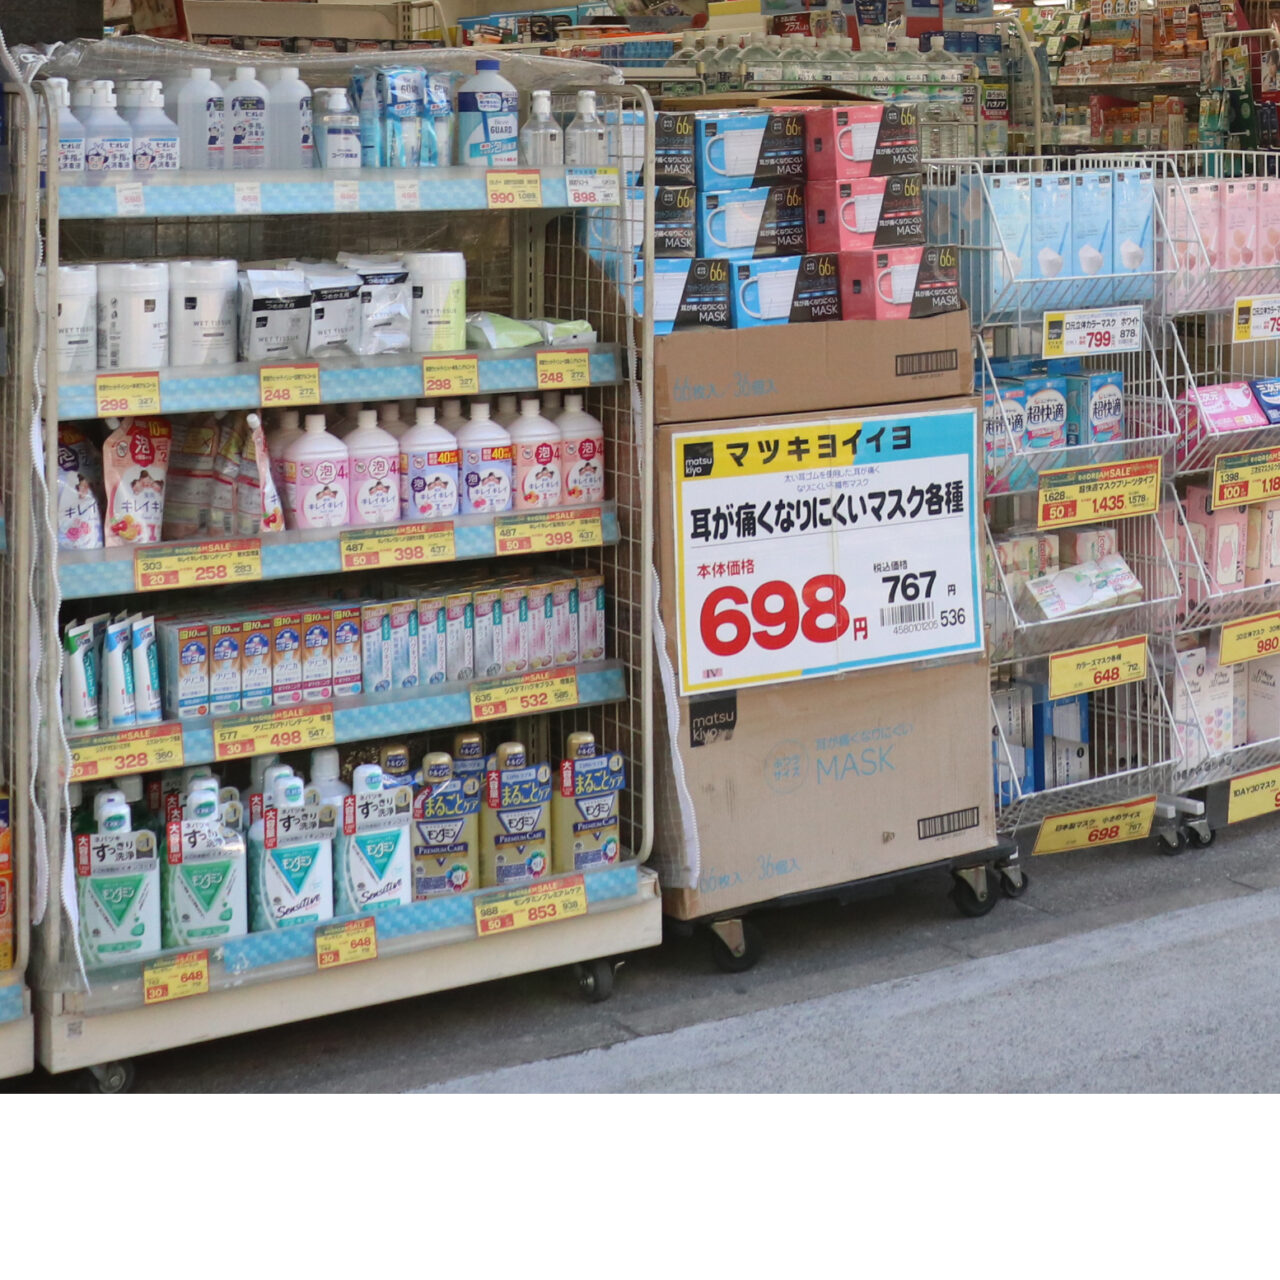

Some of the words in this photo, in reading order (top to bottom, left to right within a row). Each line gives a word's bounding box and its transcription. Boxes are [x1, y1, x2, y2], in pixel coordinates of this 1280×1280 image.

[489, 125, 513, 134] GUARD
[893, 153, 919, 165] MASK
[664, 163, 692, 175] MASK
[777, 164, 803, 175] MASK
[490, 192, 515, 204] 990
[573, 191, 596, 203] 898
[896, 224, 922, 236] MASK
[665, 237, 693, 248] MASK
[777, 234, 803, 247] MASK
[699, 310, 727, 322] MASK
[811, 304, 838, 316] MASK
[1086, 331, 1111, 348] 799
[1119, 329, 1136, 338] 878
[540, 372, 564, 384] 248
[426, 379, 451, 391] 298
[264, 388, 290, 401] 248
[100, 398, 128, 411] 298
[1092, 398, 1122, 418] 超快適
[1026, 401, 1065, 425] 超快適
[726, 425, 911, 468] マツキヨイイヨ
[685, 455, 713, 467] matsu
[685, 464, 703, 476] kiyo
[1109, 467, 1131, 478] SALE
[1223, 485, 1240, 498] 100
[690, 480, 964, 543] 耳が痛くなりにくいマスク各種
[1049, 506, 1065, 519] 50
[500, 528, 516, 537] 487
[545, 531, 574, 546] 398
[345, 543, 364, 552] 487
[506, 540, 519, 550] 50
[353, 555, 366, 565] 50
[394, 546, 424, 561] 398
[697, 558, 755, 579] 本体価格
[873, 559, 909, 573] 税込価格
[195, 565, 227, 581] 258
[882, 570, 937, 603] 767
[947, 583, 957, 597] 円
[699, 573, 850, 658] 698
[853, 616, 869, 642] 円
[939, 607, 966, 628] 536
[1257, 636, 1279, 653] 980
[1093, 666, 1120, 685] 648
[481, 706, 495, 715] 50
[520, 693, 548, 708] 532
[692, 710, 735, 727] matsu
[219, 730, 239, 741] 577
[270, 730, 302, 746] 498
[226, 744, 242, 754] 30
[114, 752, 148, 770] 328
[816, 744, 896, 785] MASK
[575, 772, 624, 795] まるごとケア
[501, 784, 553, 807] まるごとケア
[1088, 824, 1120, 843] 698
[275, 893, 323, 919] Sensitive
[488, 920, 502, 930] 50
[528, 903, 558, 922] 853
[180, 971, 203, 983] 648
